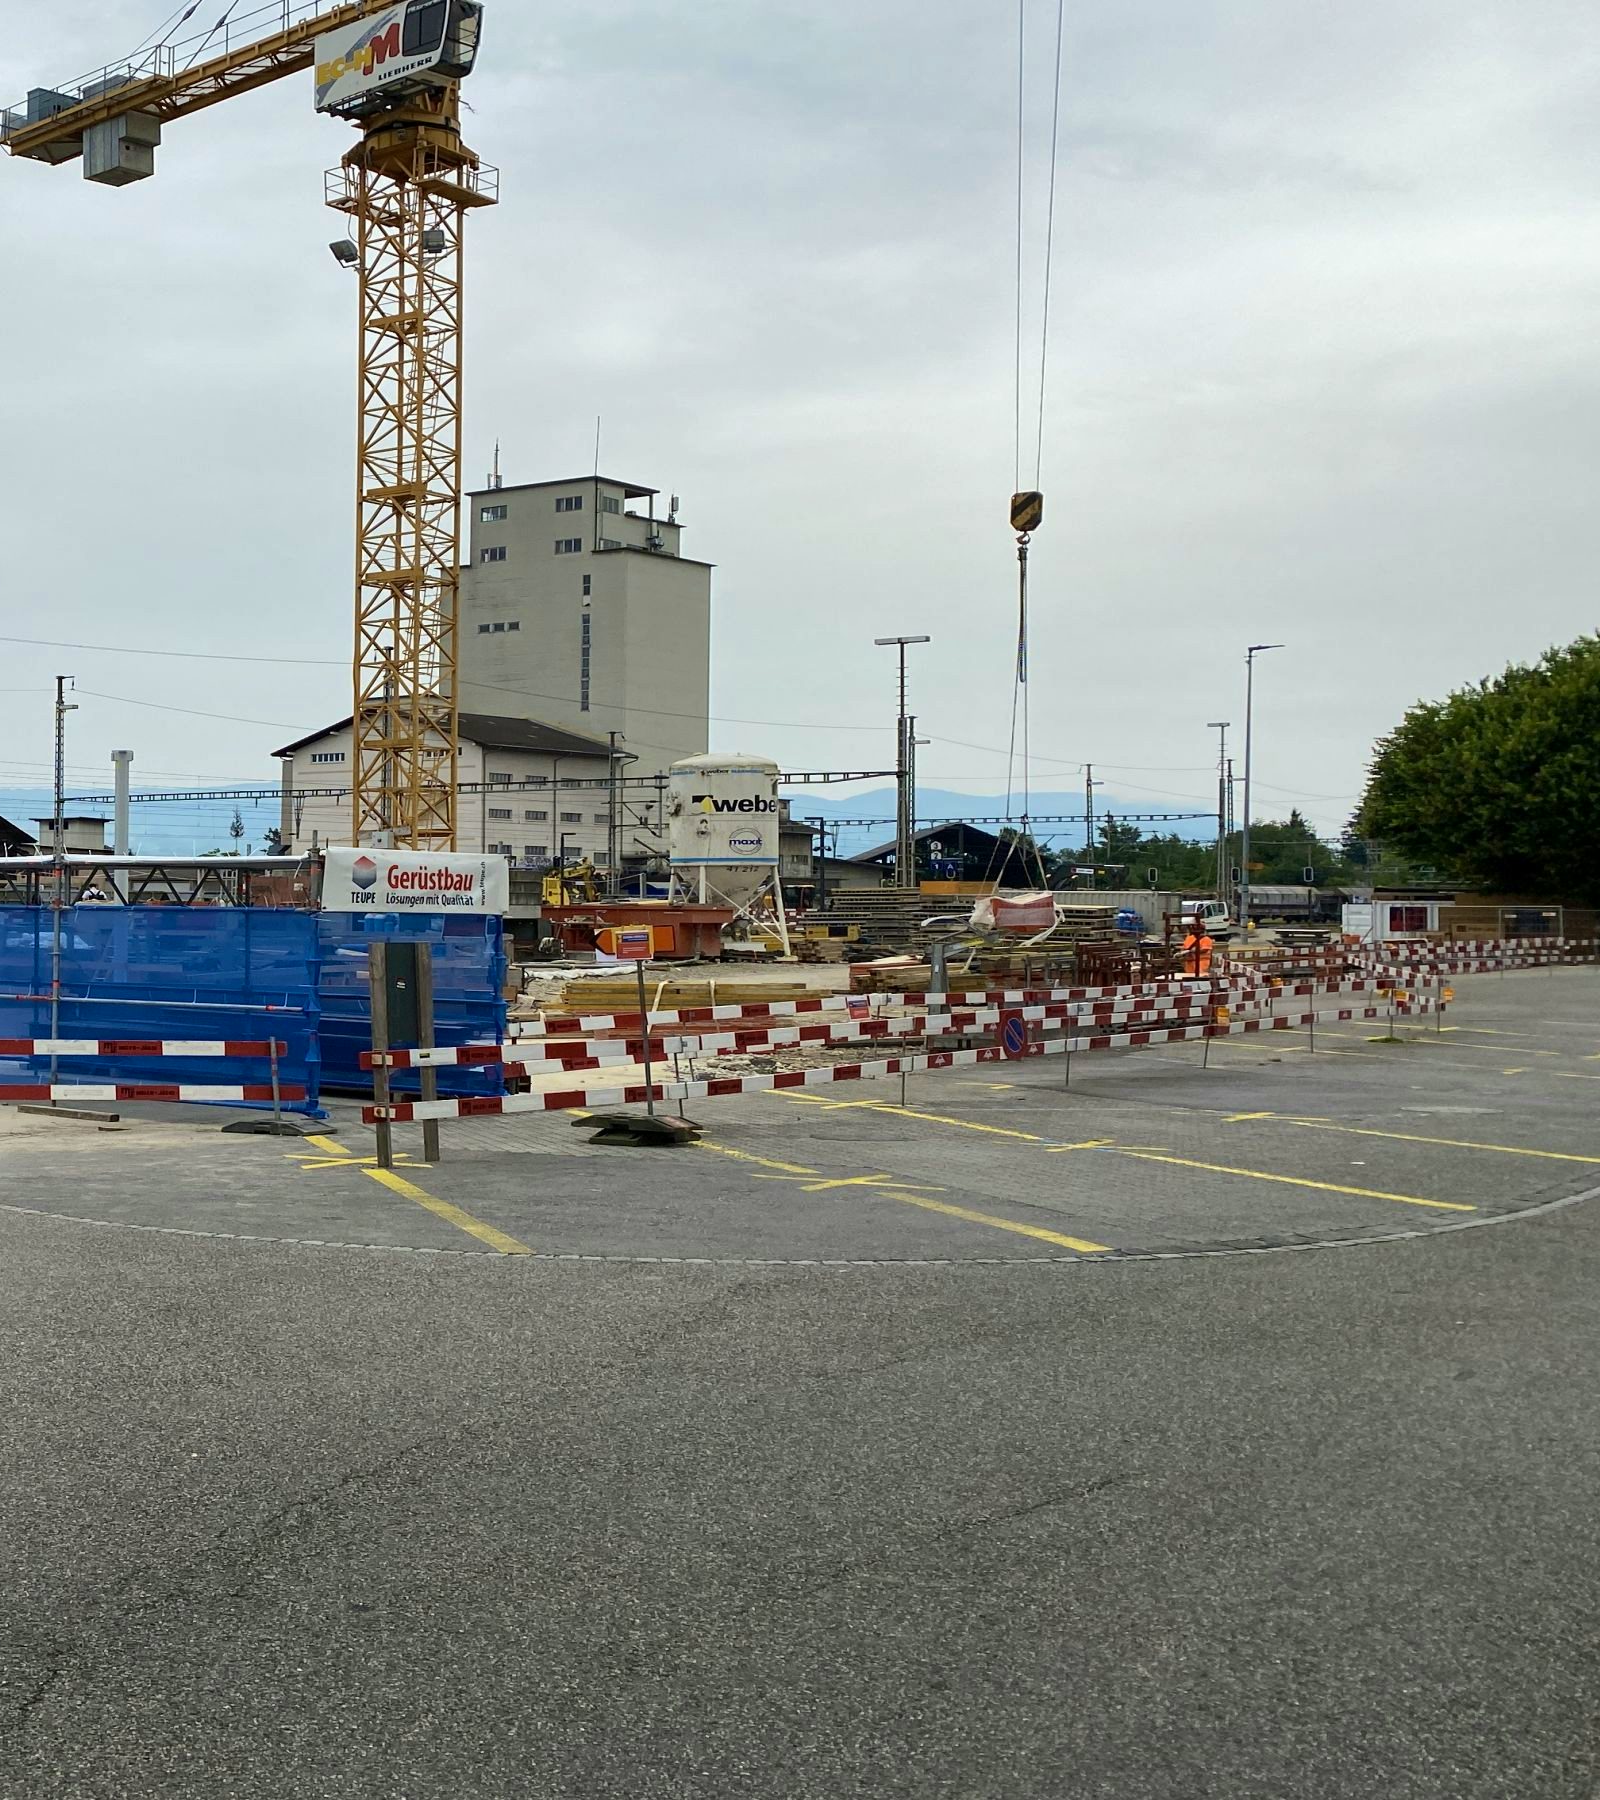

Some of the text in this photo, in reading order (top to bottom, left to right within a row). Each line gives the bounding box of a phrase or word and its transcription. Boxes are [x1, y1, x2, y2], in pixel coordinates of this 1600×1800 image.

[378, 56, 433, 81] LIEBHERR
[729, 837, 763, 846] maxit
[387, 864, 474, 892] Gerüstbau
[351, 891, 376, 904] TEUPE
[386, 891, 474, 907] Lösungen mit Qualität
